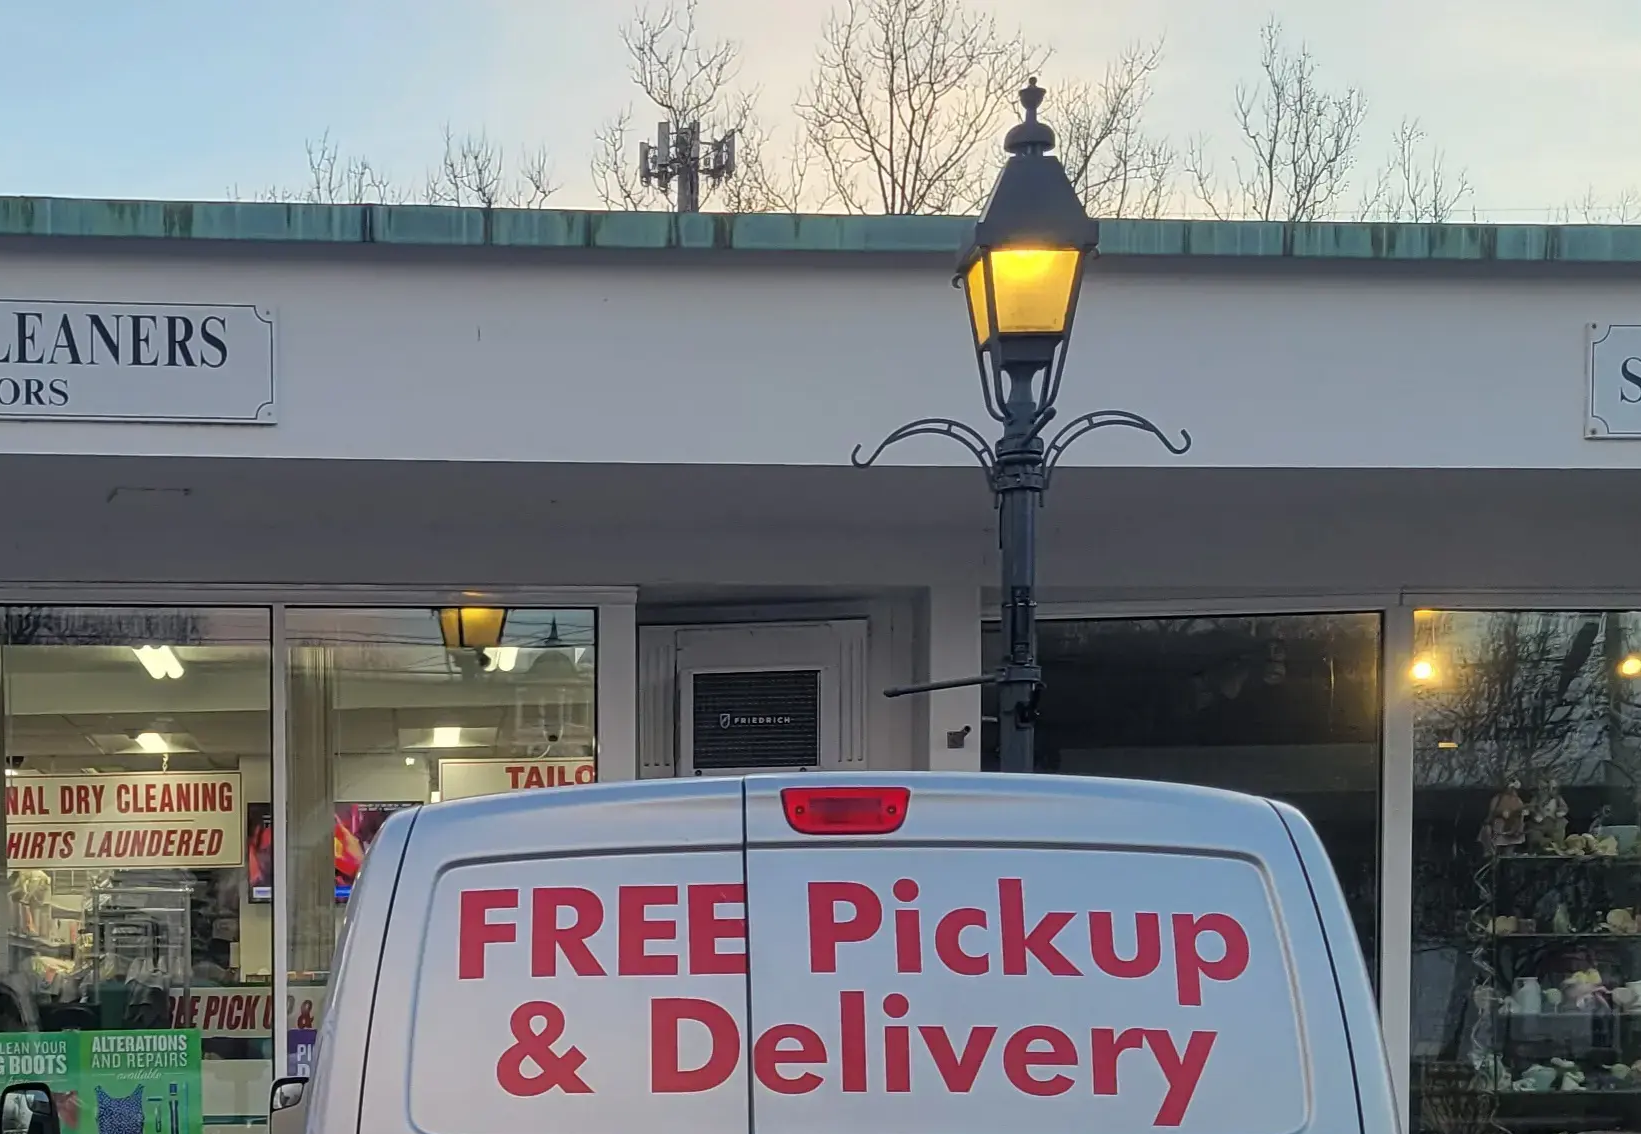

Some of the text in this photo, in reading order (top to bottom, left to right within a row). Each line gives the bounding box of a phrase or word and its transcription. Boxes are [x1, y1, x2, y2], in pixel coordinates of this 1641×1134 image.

[734, 716, 791, 724] FRIEDRICH
[60, 784, 105, 815] DRY
[116, 782, 233, 814] CLEANING
[7, 831, 76, 860] HIRTS
[83, 828, 223, 858] LAUNDERED
[458, 878, 1250, 1006] FREE Pickup
[203, 994, 261, 1030] PICK
[33, 1041, 67, 1054] YOUR
[92, 1034, 188, 1053] ALTERATIONS
[9, 1054, 68, 1075] BOOTS
[92, 1052, 188, 1069] AND REPAIRS
[496, 991, 1217, 1127] & Delivery
